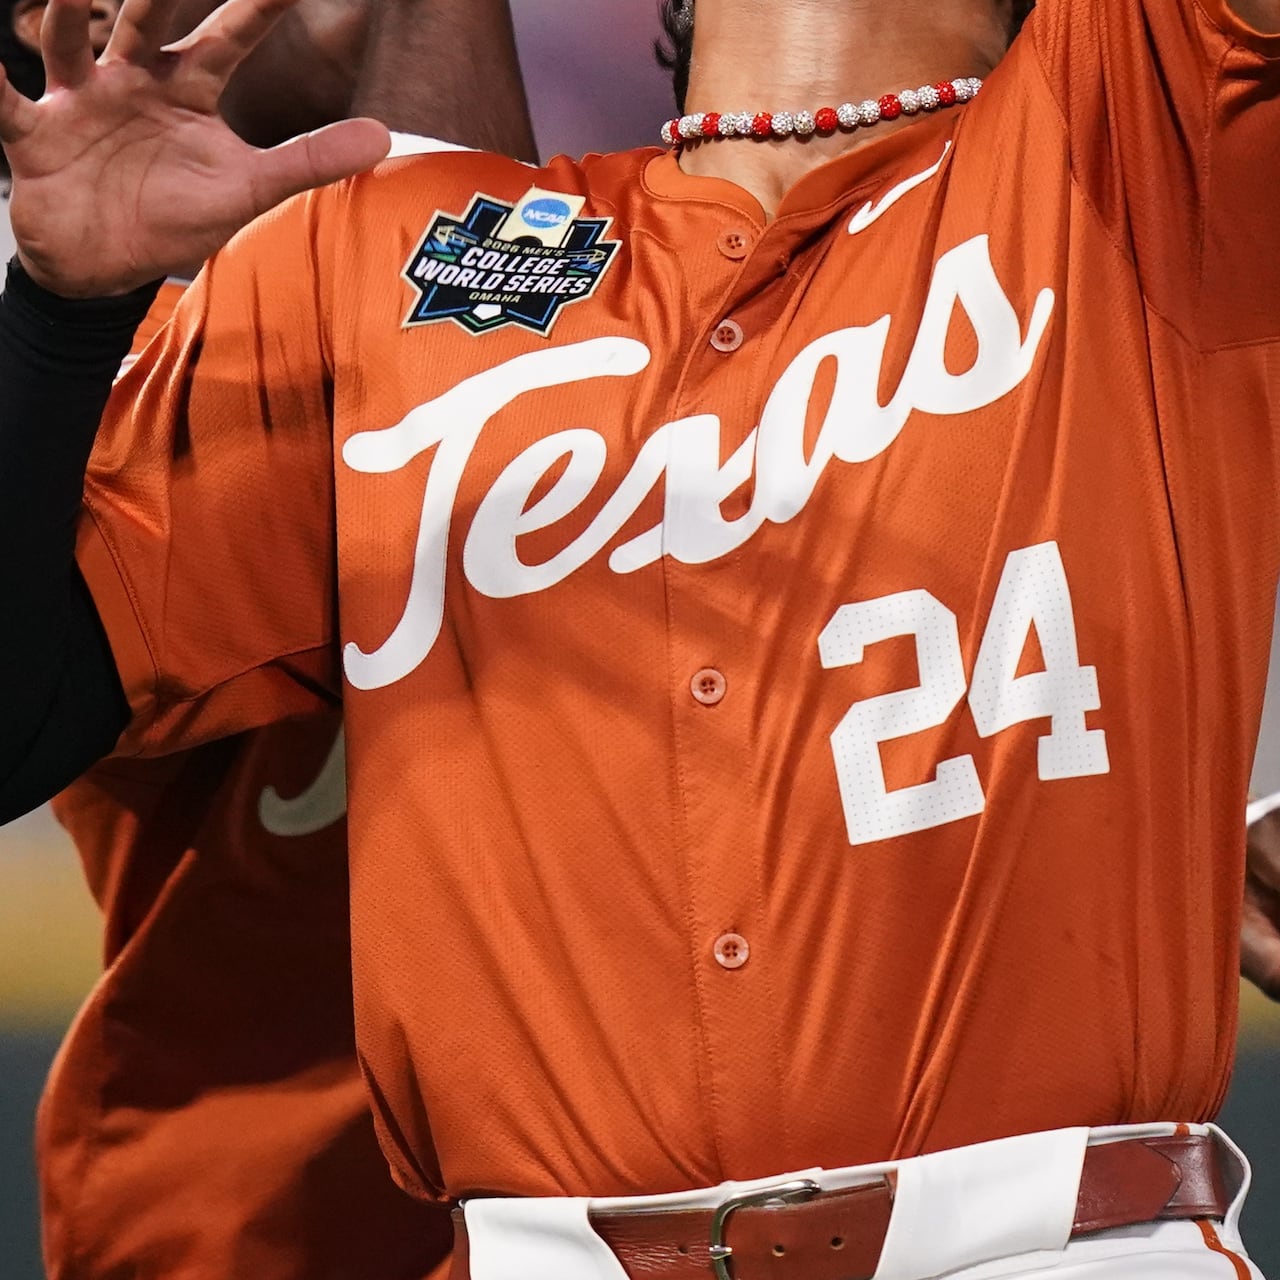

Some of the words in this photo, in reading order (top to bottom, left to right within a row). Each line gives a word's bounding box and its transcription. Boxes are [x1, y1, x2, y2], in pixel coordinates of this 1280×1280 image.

[523, 208, 568, 224] NCAA
[460, 246, 571, 275] COLLEGE
[521, 246, 566, 257] MEN'S
[413, 256, 505, 291] WORLD
[502, 274, 593, 294] SERIES
[468, 291, 522, 304] OMAHA
[342, 234, 1055, 690] Texas
[817, 540, 1110, 846] 24
